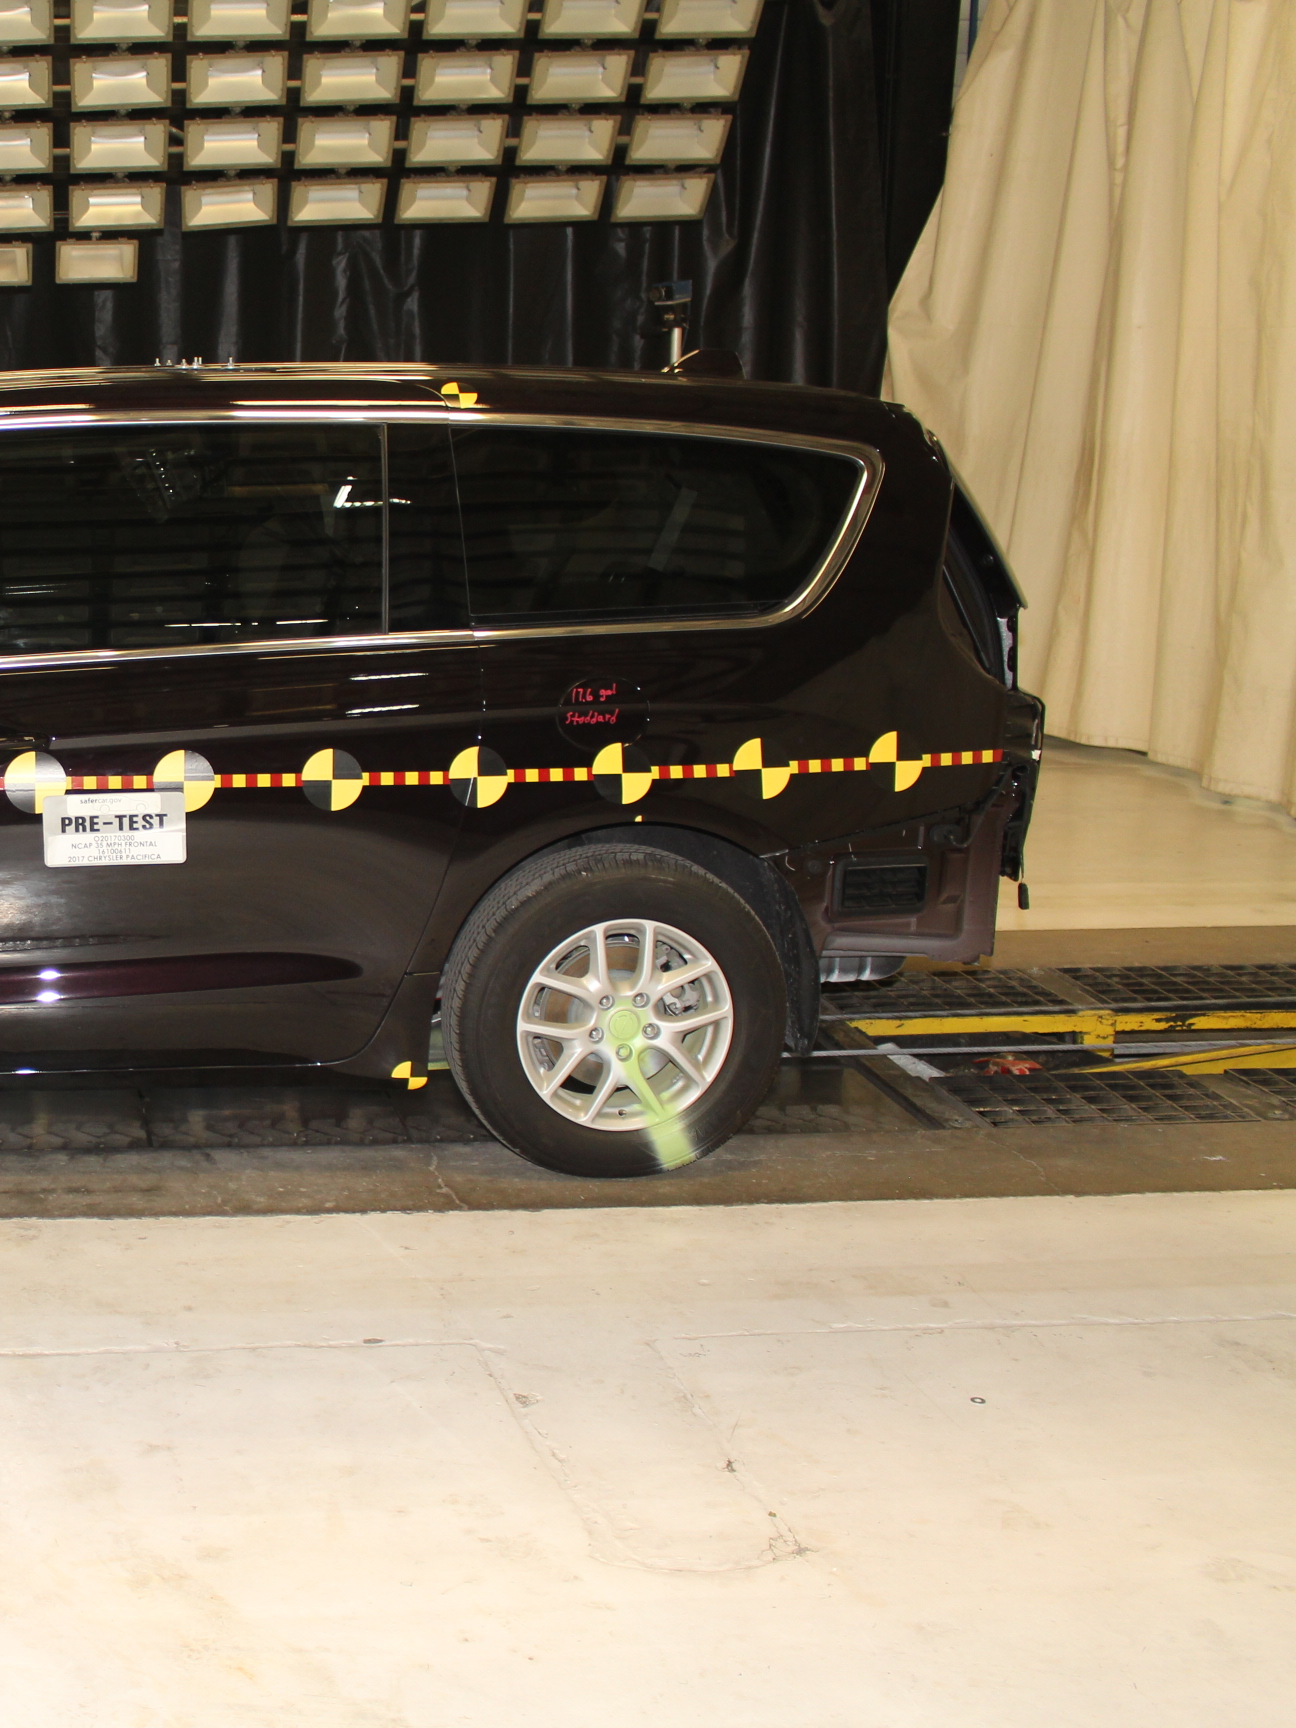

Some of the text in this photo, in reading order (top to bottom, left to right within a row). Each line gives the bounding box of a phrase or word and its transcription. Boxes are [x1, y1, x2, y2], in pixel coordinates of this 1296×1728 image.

[572, 688, 594, 703] 17.6
[60, 813, 168, 834] PRE-TEST
[71, 842, 93, 850] NCAP
[87, 854, 124, 862] CHRYSLER
[126, 853, 161, 861] PACIFICA
